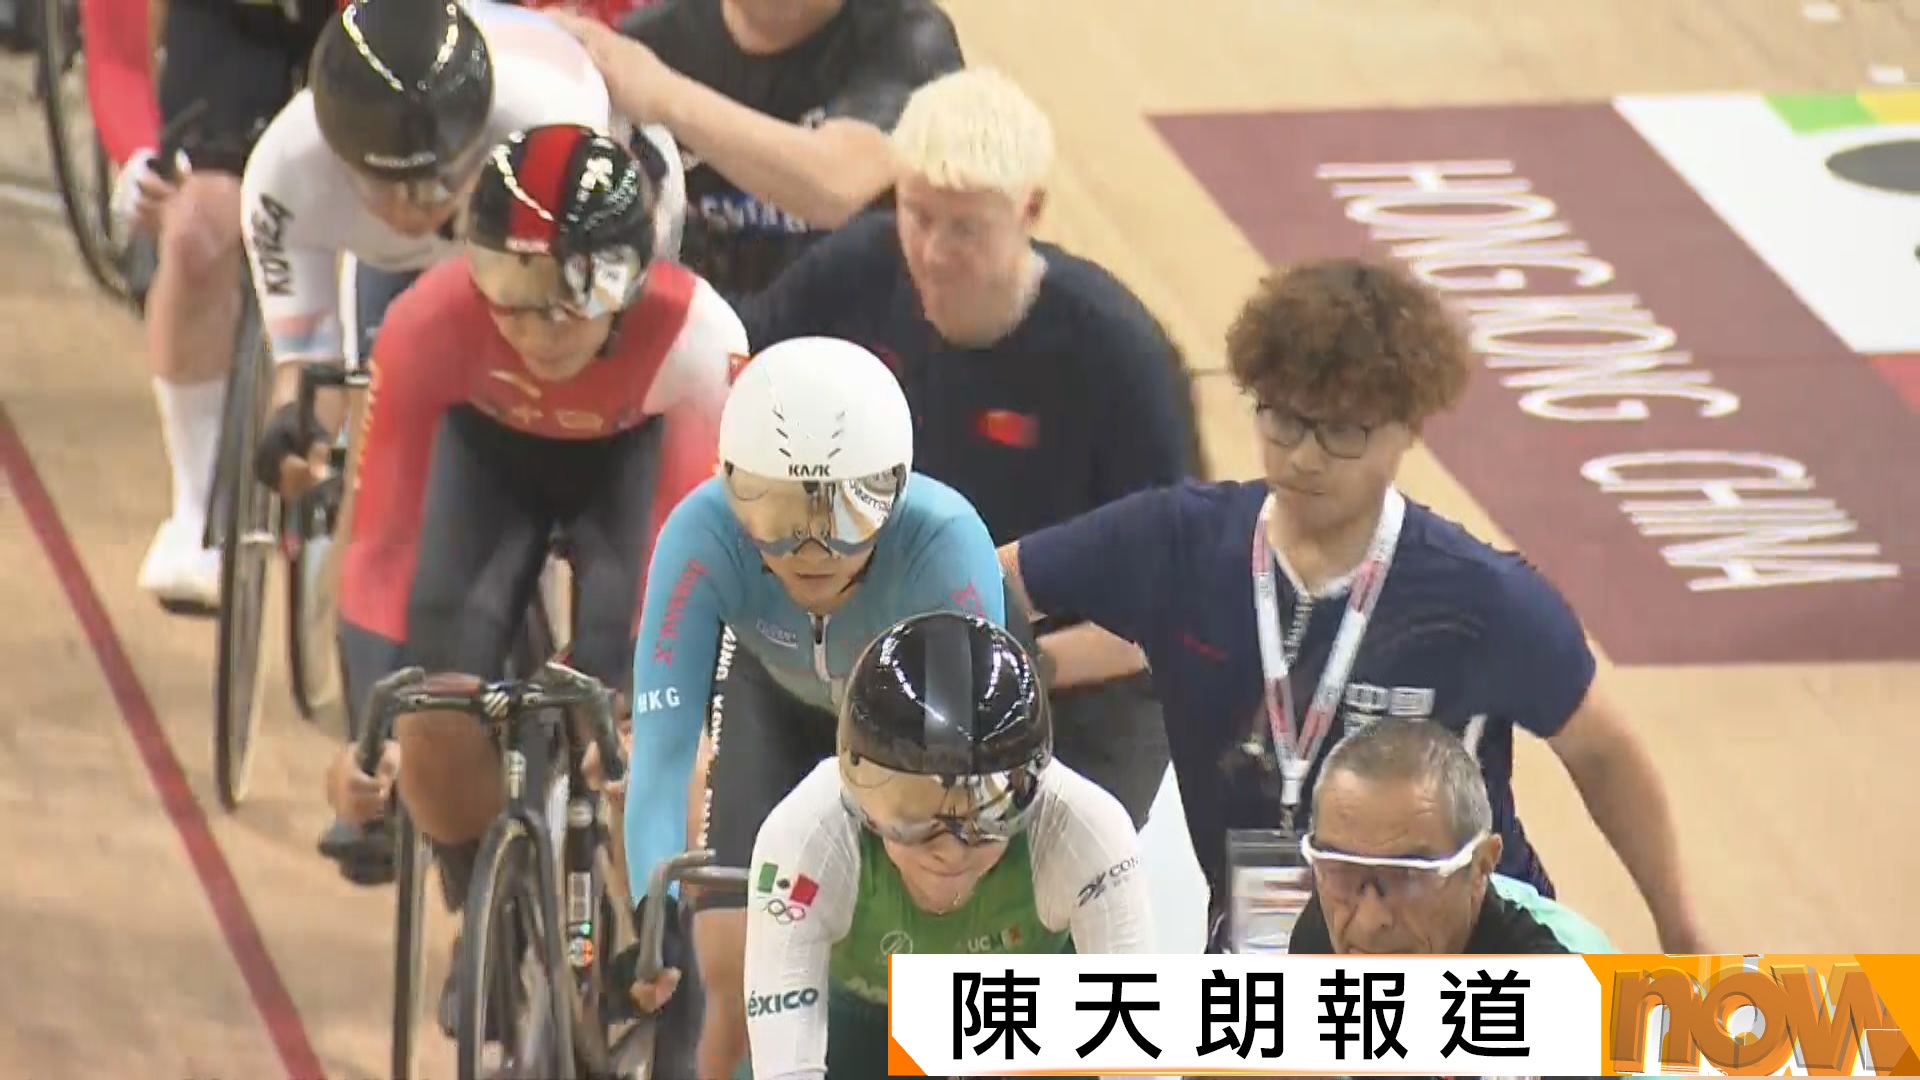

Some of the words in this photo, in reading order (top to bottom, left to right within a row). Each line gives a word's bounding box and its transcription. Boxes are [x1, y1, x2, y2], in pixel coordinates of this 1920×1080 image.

[1315, 159, 1615, 289] HONG
[1463, 294, 1741, 421] KONG
[1580, 449, 1900, 592] CHINA
[637, 686, 681, 713] HKG
